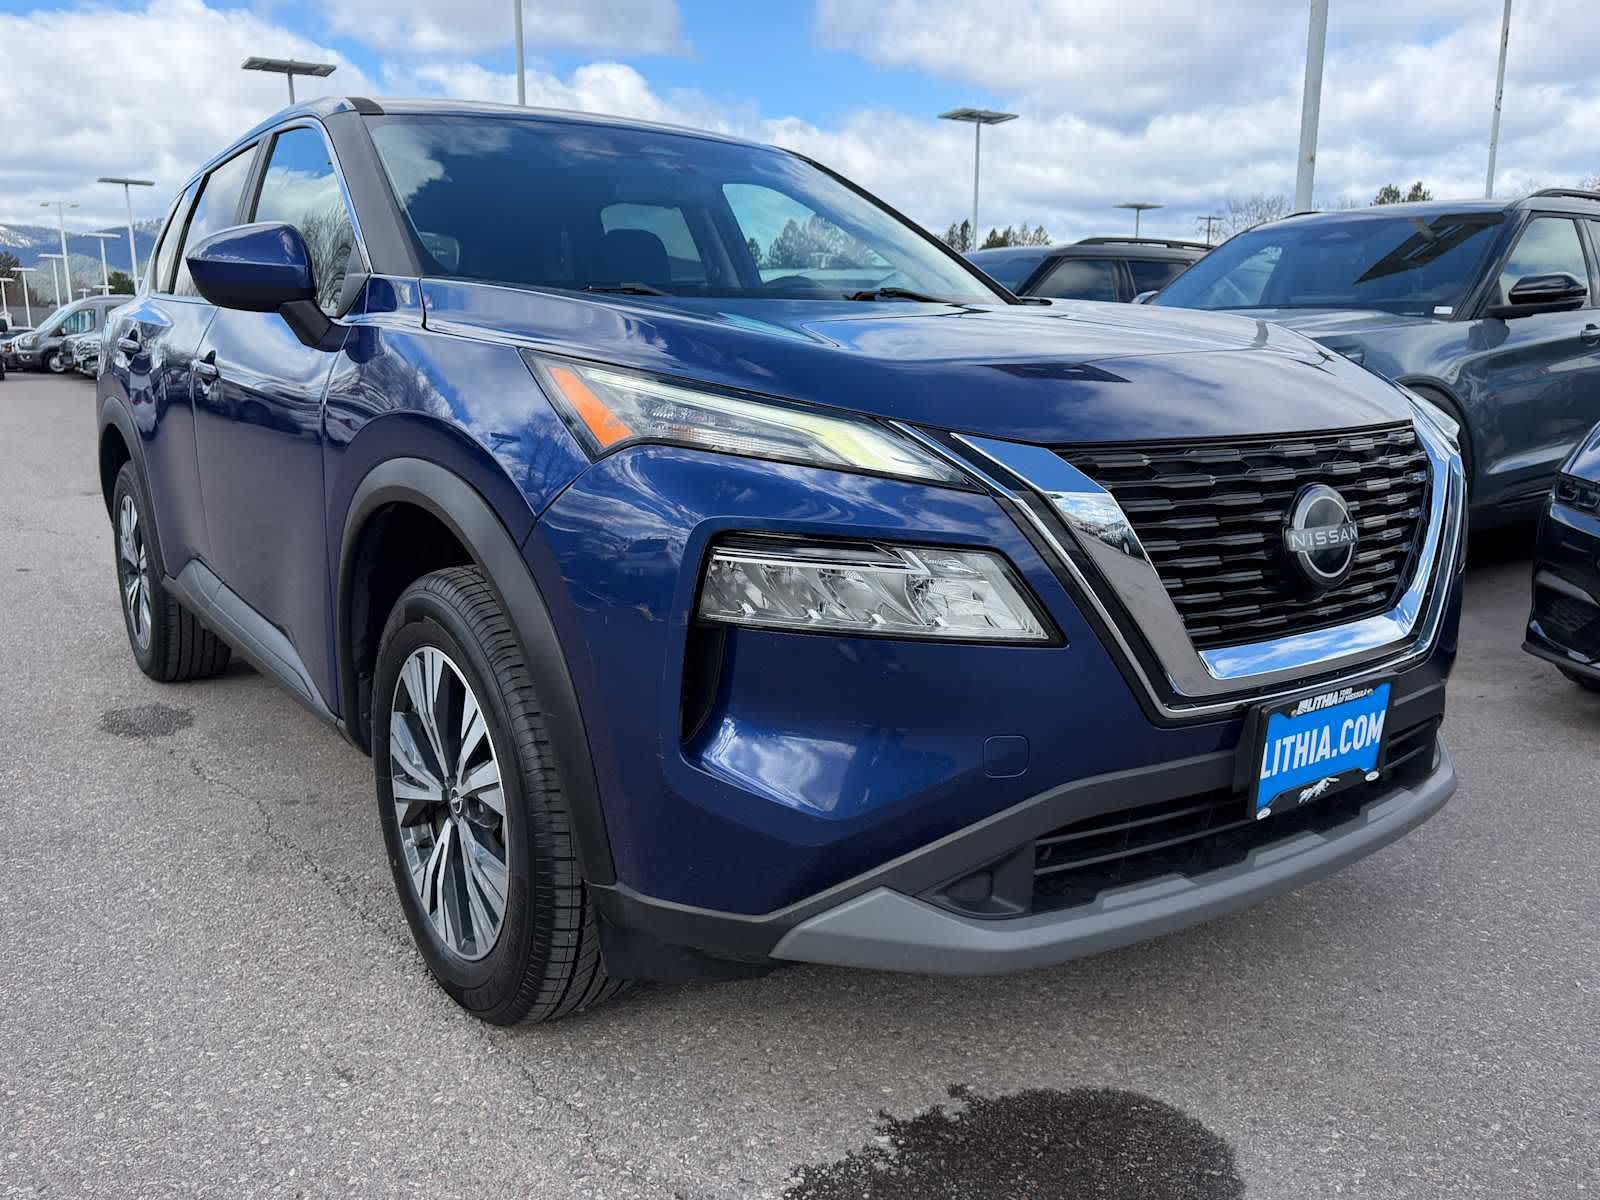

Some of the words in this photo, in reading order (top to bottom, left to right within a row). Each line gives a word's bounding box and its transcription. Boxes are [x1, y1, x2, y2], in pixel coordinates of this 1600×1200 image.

[1291, 523, 1358, 548] NISSAN
[1308, 691, 1338, 712] LITHIA
[1260, 709, 1386, 779] LITHIA.COM
